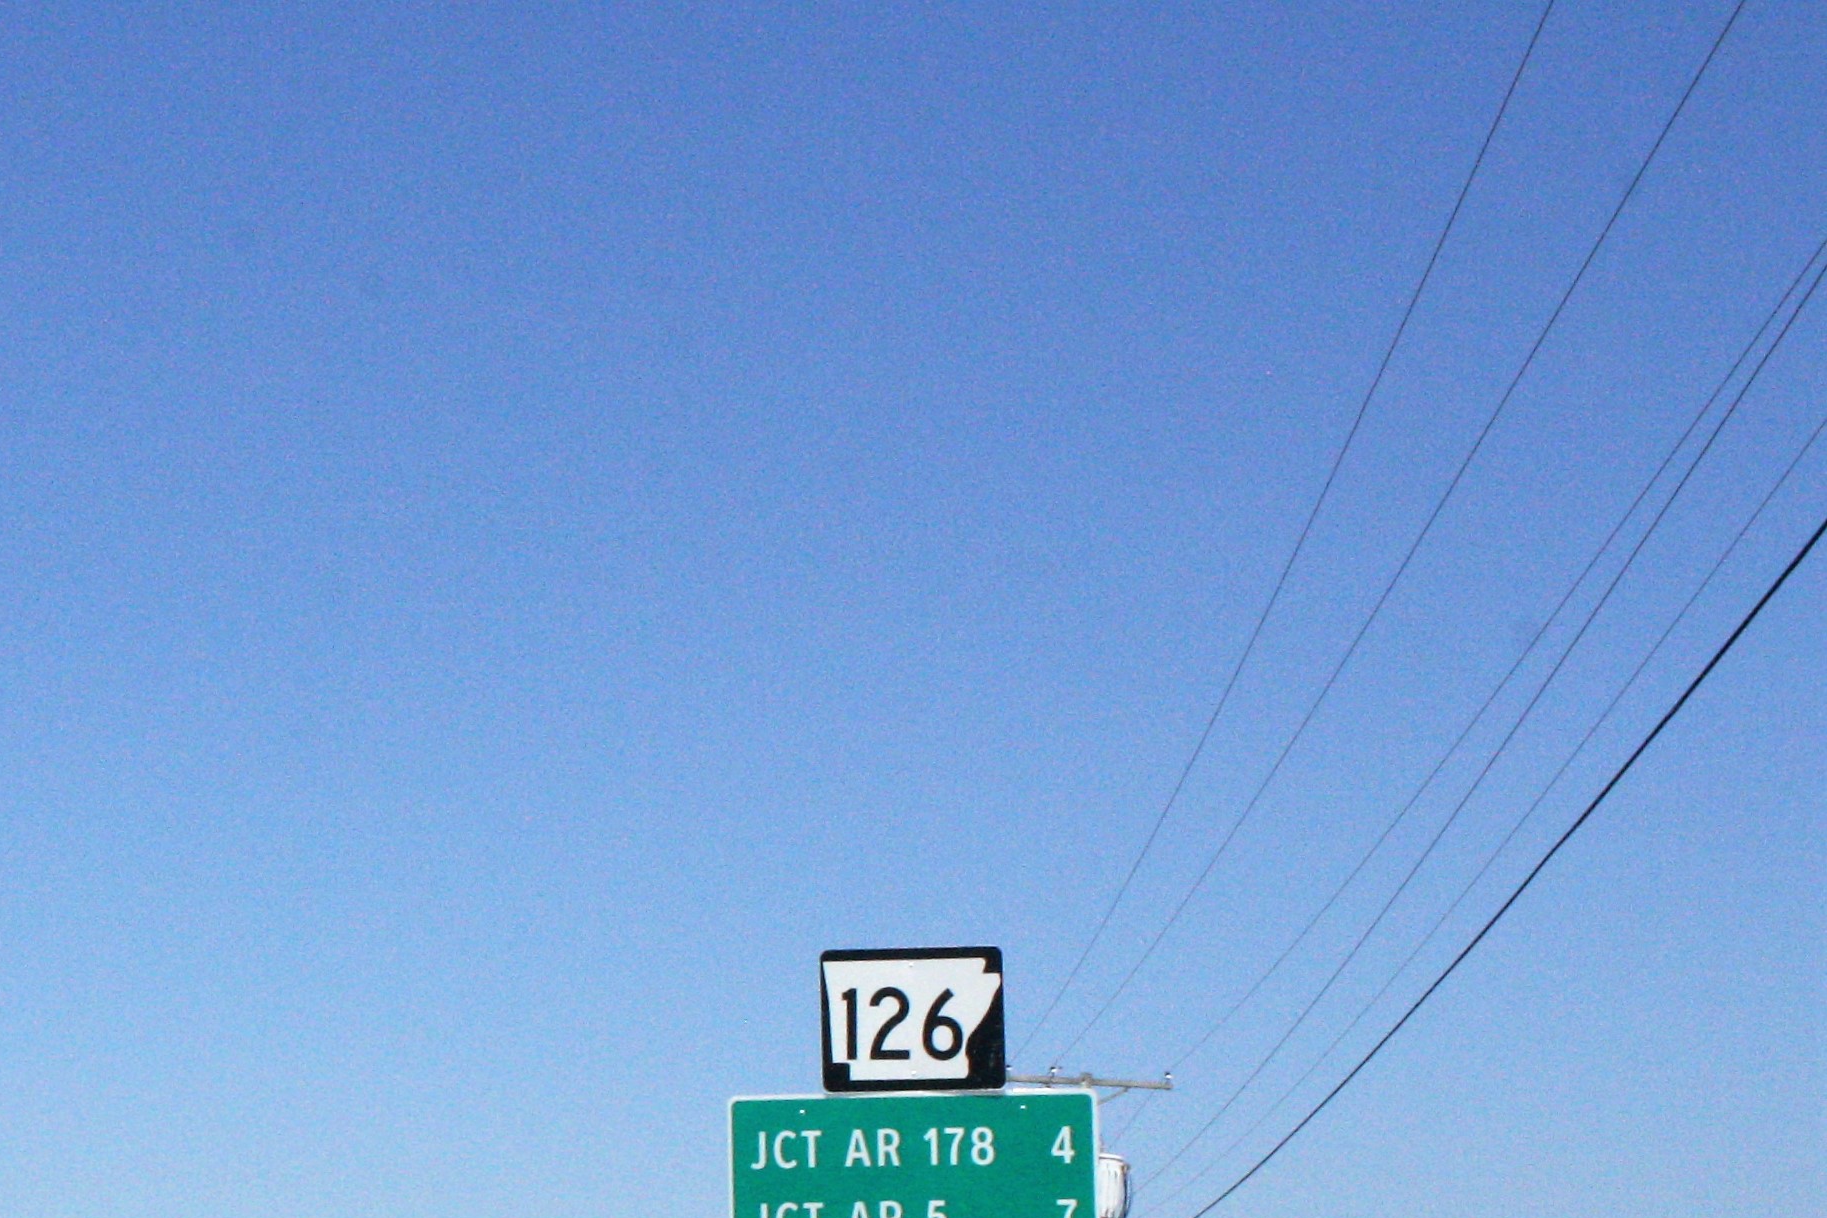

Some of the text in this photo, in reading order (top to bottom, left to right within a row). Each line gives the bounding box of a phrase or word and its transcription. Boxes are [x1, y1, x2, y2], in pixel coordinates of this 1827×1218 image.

[841, 986, 963, 1061] 126
[750, 1126, 1075, 1169] JCT AR 178 4
